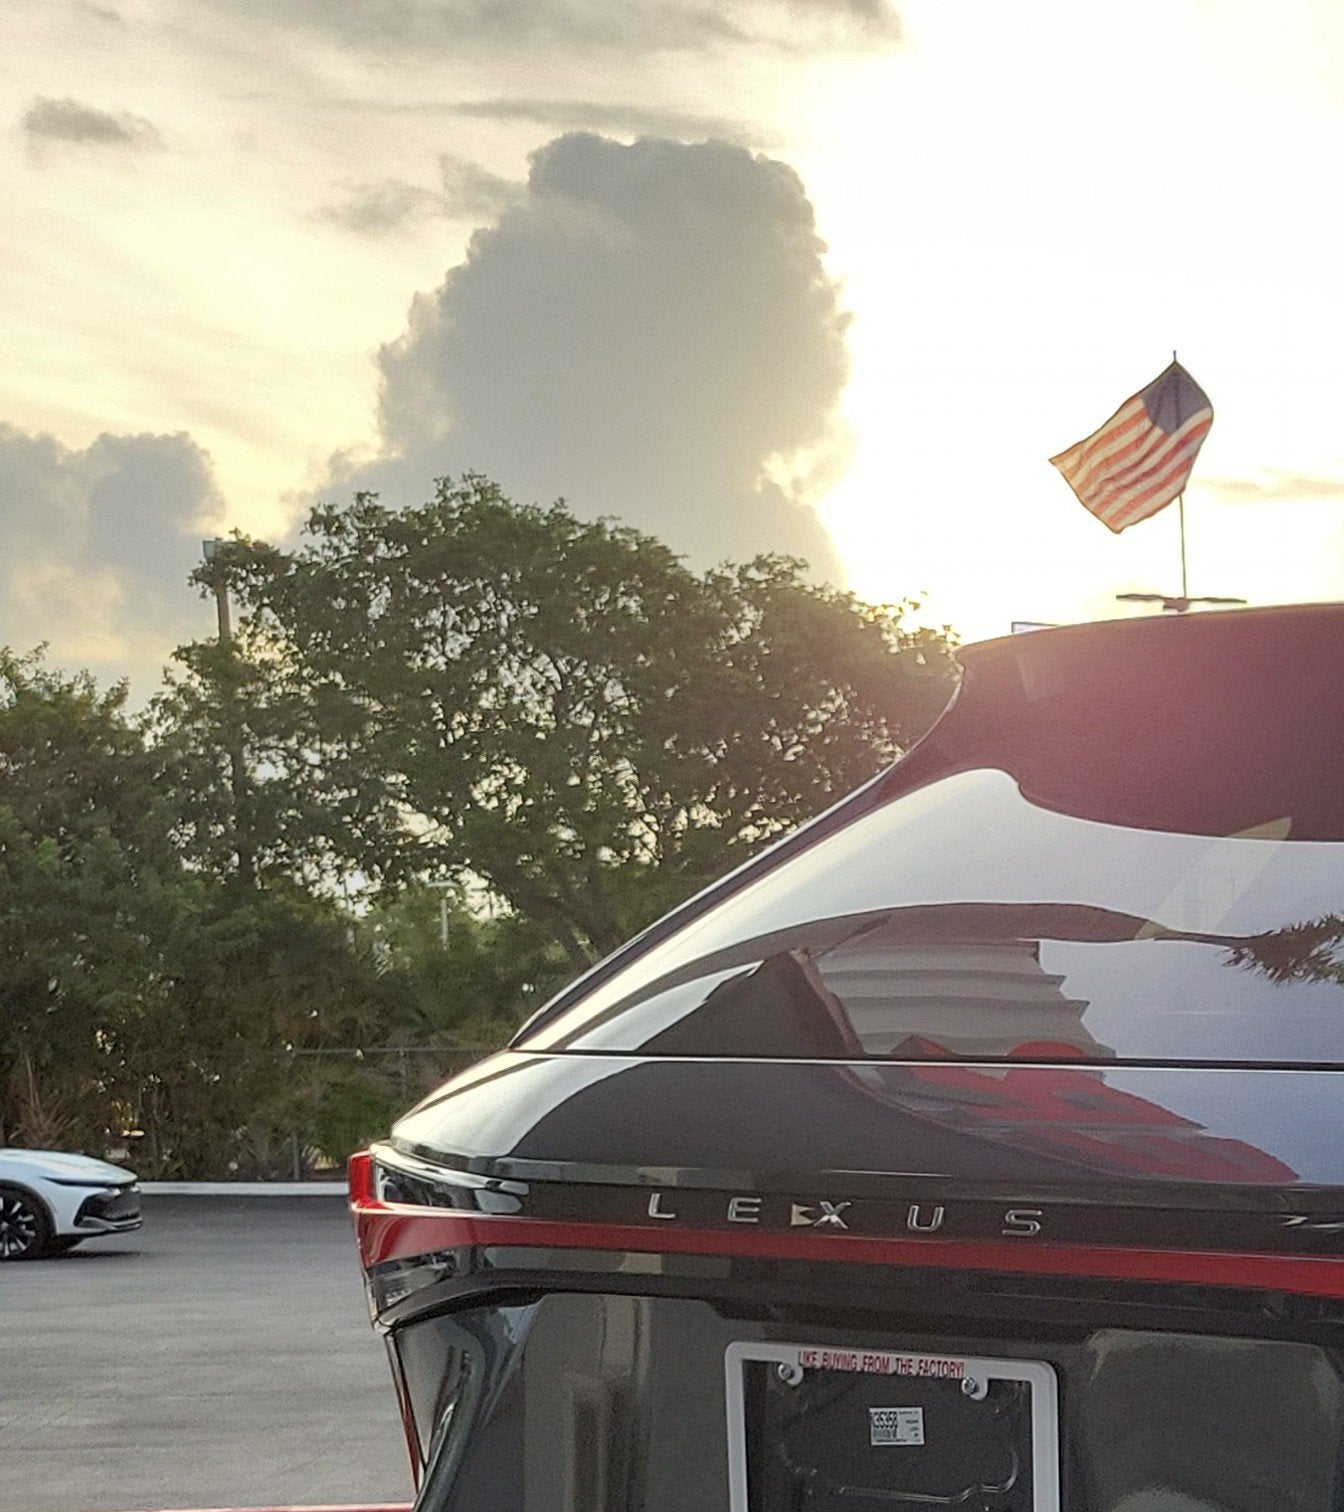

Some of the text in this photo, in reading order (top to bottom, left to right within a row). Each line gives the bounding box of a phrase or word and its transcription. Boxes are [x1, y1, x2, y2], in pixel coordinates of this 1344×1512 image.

[647, 1192, 1043, 1237] LEXUS
[799, 1350, 818, 1369] LIKE
[822, 1352, 858, 1372] BUYING
[863, 1355, 890, 1374] FROM
[895, 1357, 914, 1376] THE
